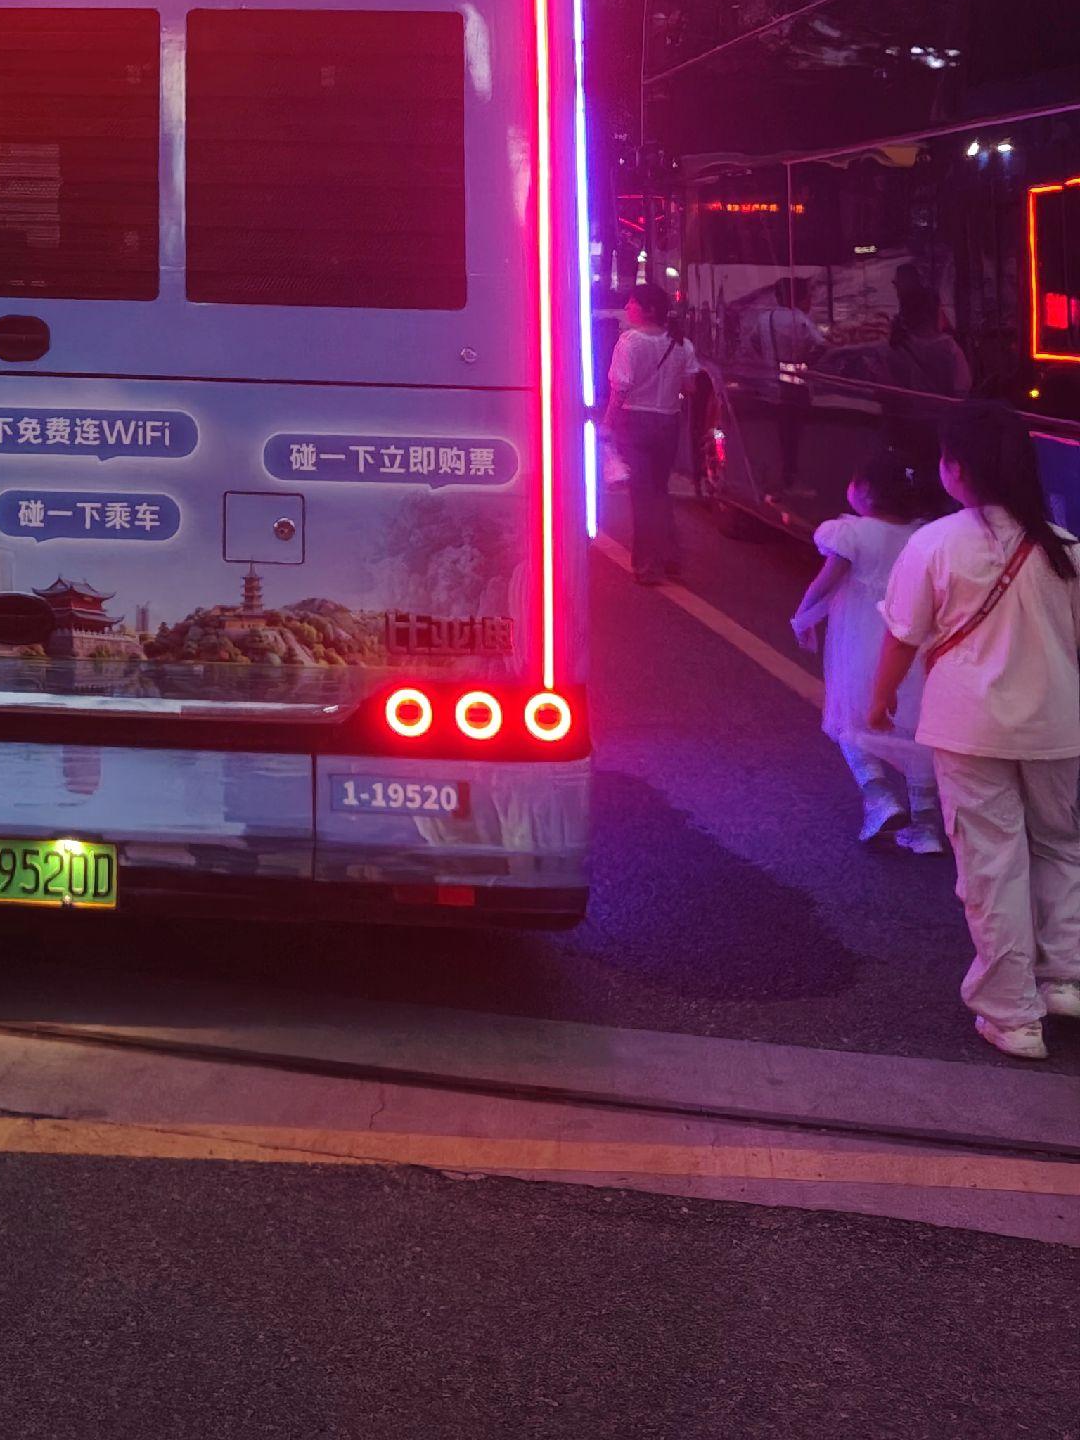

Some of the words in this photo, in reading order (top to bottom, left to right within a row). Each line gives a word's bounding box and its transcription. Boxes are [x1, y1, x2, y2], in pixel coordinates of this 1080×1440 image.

[289, 443, 496, 476] 碰一下立即购票
[18, 499, 161, 531] 碰一下乘车
[343, 780, 460, 812] 1-19520
